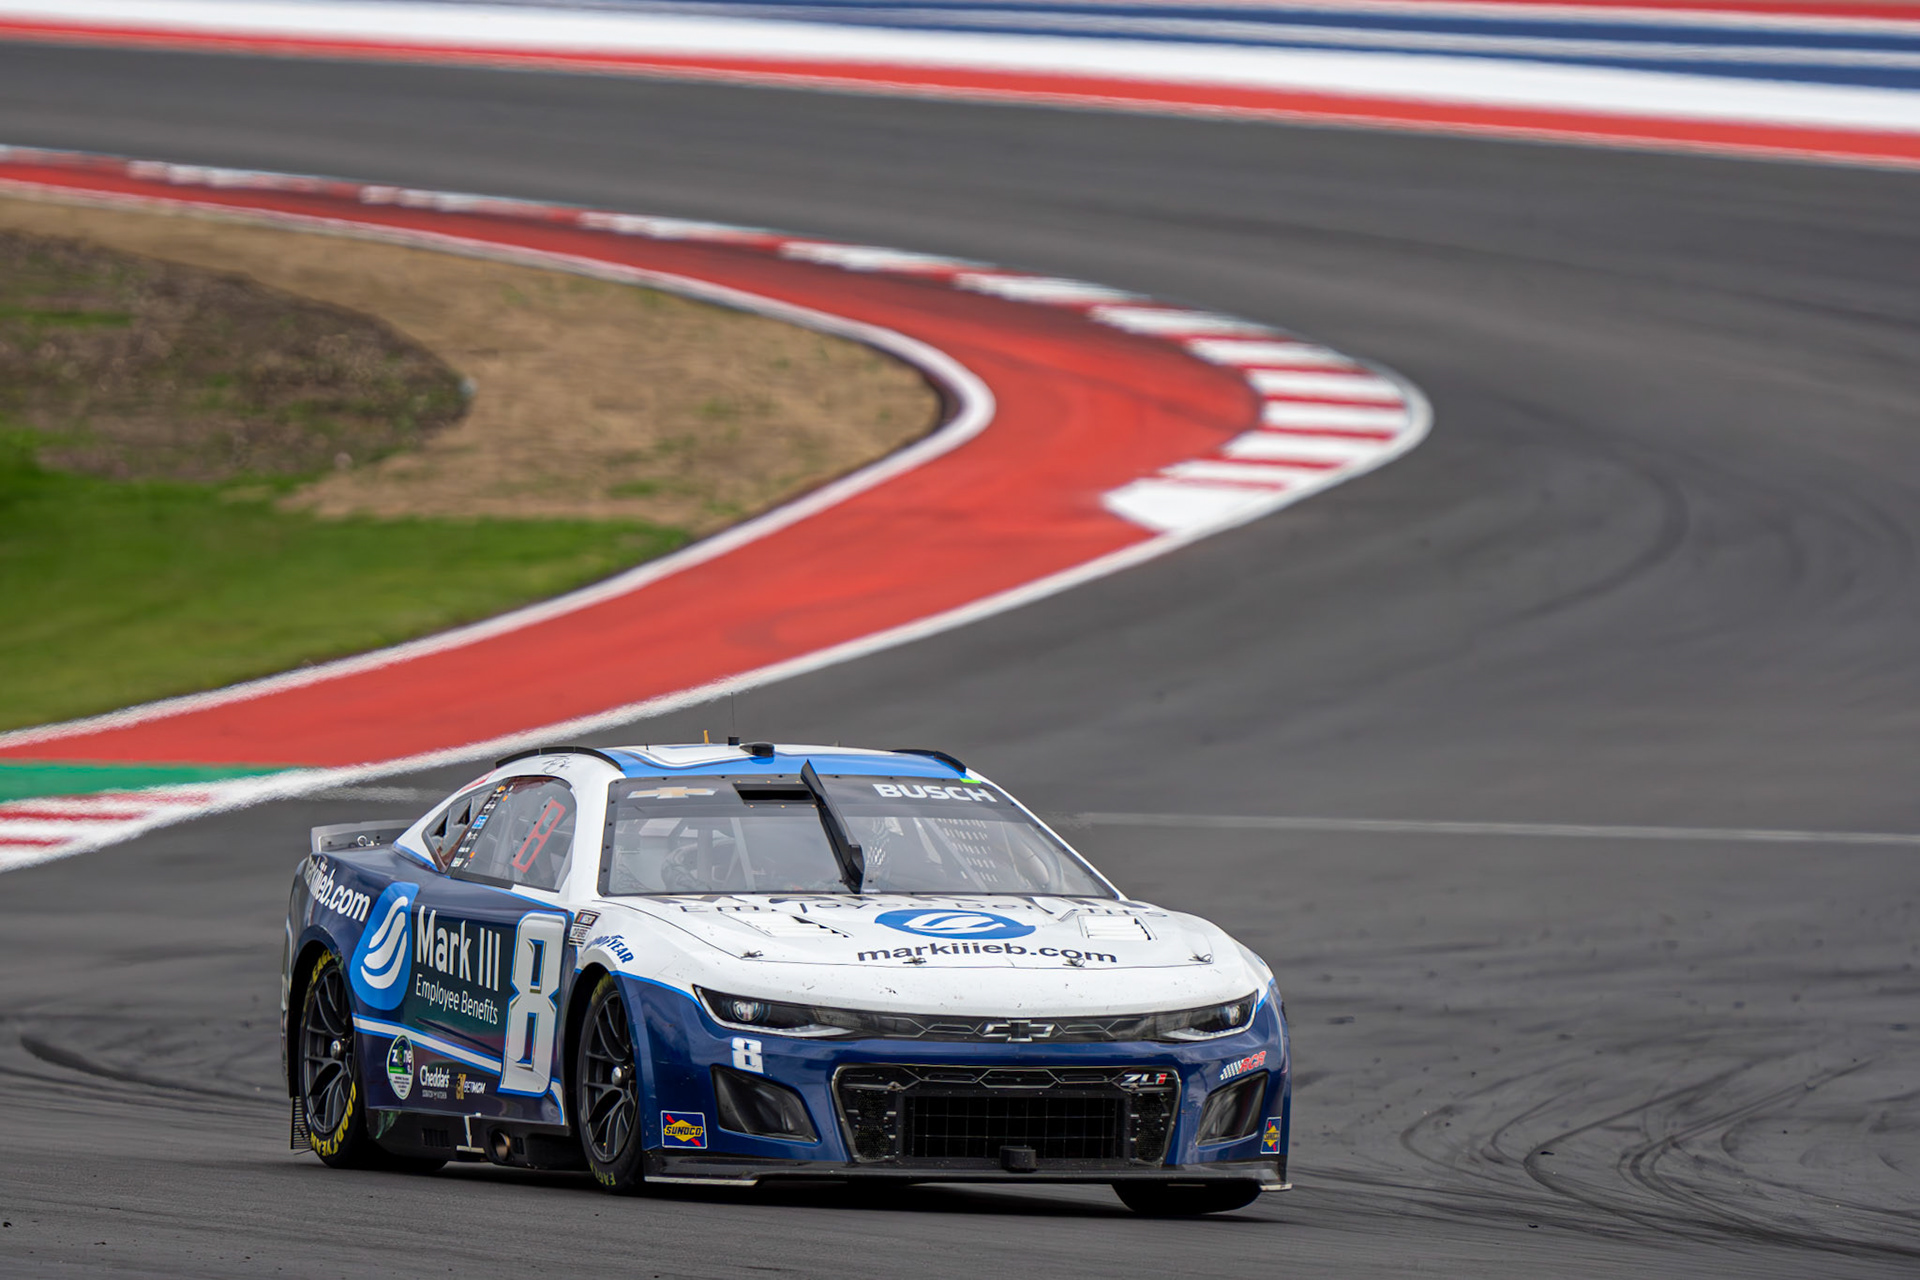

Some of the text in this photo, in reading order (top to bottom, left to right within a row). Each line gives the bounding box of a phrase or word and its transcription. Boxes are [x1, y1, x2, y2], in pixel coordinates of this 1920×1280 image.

[872, 783, 998, 802] BUSCH
[416, 905, 501, 992] Mark III
[857, 942, 1117, 963] markiiieb.com
[416, 973, 499, 1025] Employee Benefits
[499, 912, 567, 1096] 8
[731, 1037, 764, 1074] 8
[665, 1125, 703, 1136] SUNOCO
